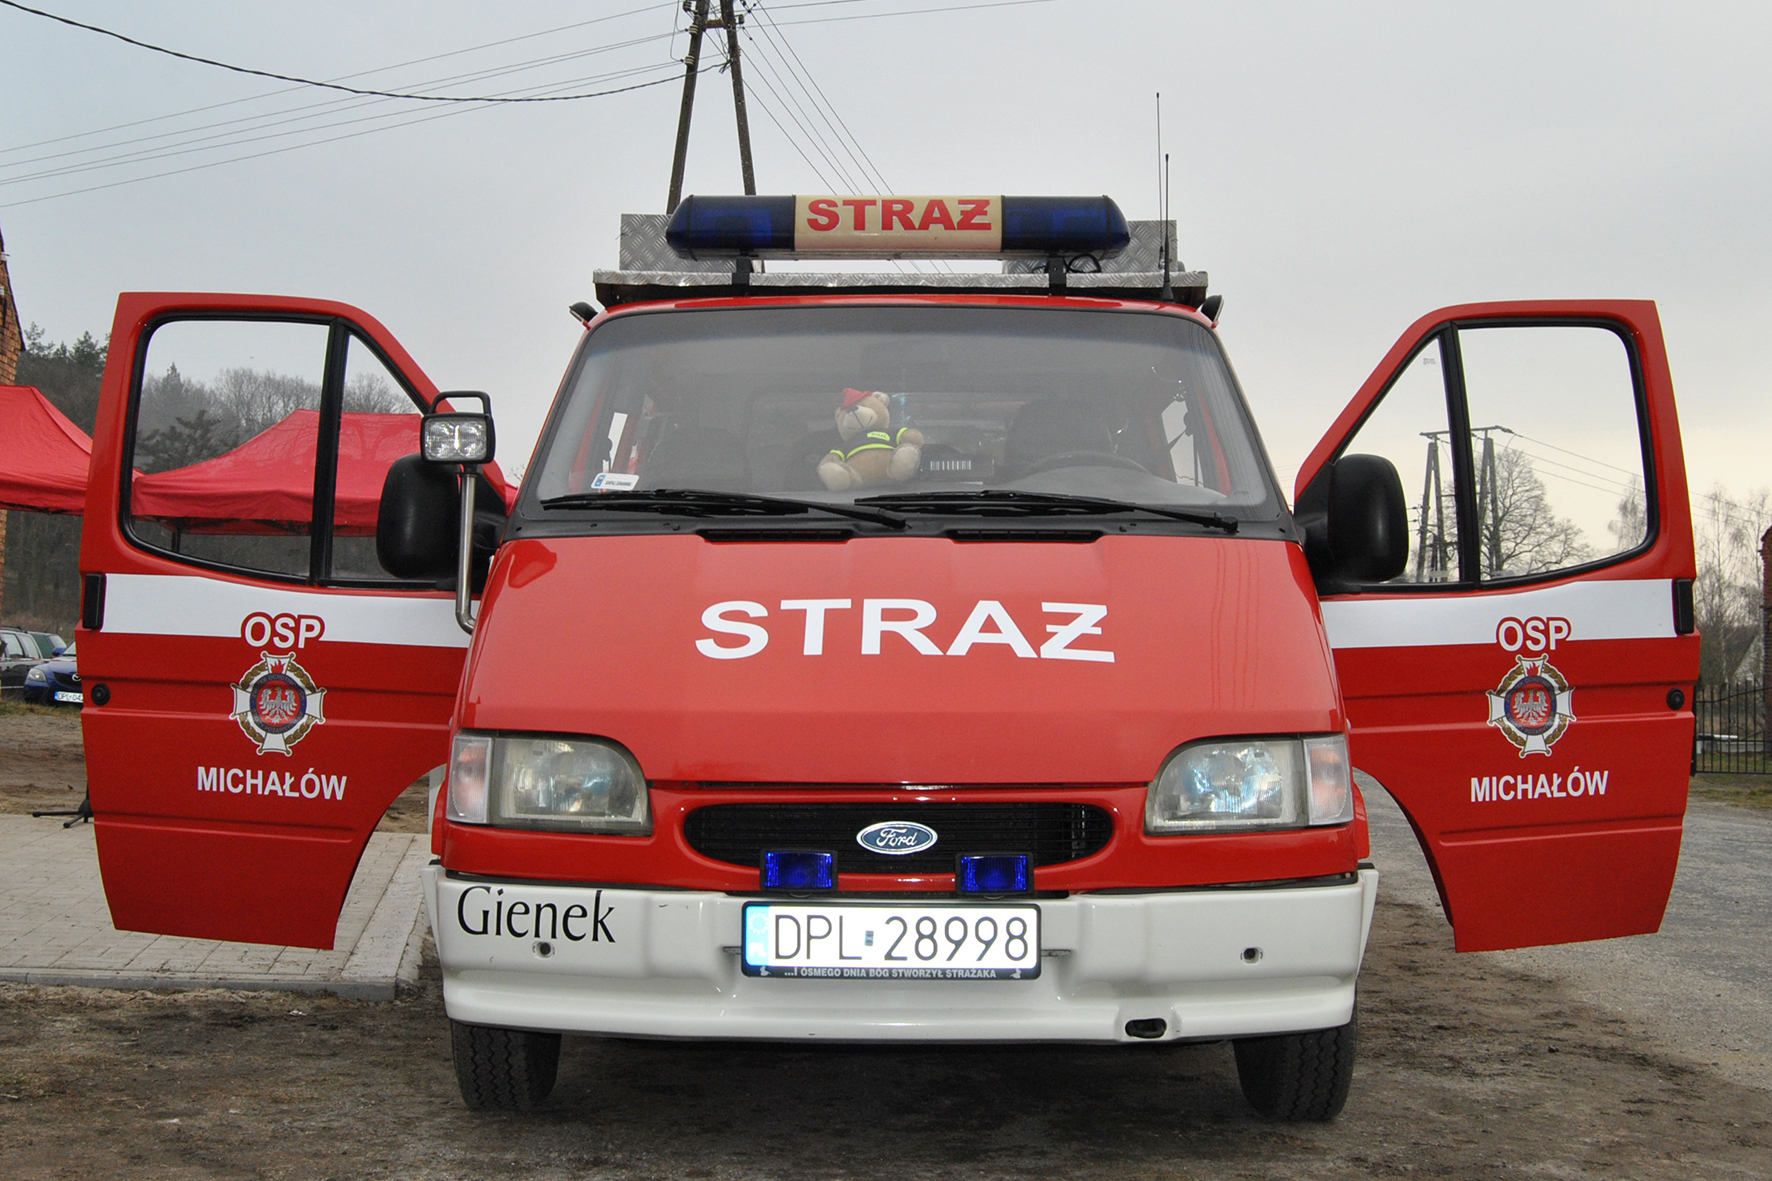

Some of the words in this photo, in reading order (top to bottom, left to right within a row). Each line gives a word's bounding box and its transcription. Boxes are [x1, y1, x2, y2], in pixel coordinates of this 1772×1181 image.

[244, 615, 321, 649] OSP
[1498, 619, 1570, 652] OSP
[197, 766, 348, 801] MICHAŁÓW
[1470, 765, 1609, 803] MICHAŁÓW
[876, 828, 918, 847] Ford
[457, 885, 617, 943] Gienek
[775, 914, 862, 961] DPL
[884, 915, 1029, 962] 28998
[843, 968, 867, 977] DNIA
[869, 966, 889, 977] BÓG
[892, 968, 943, 978] STWORZYŁ
[945, 968, 997, 978] STRAŻAKA
